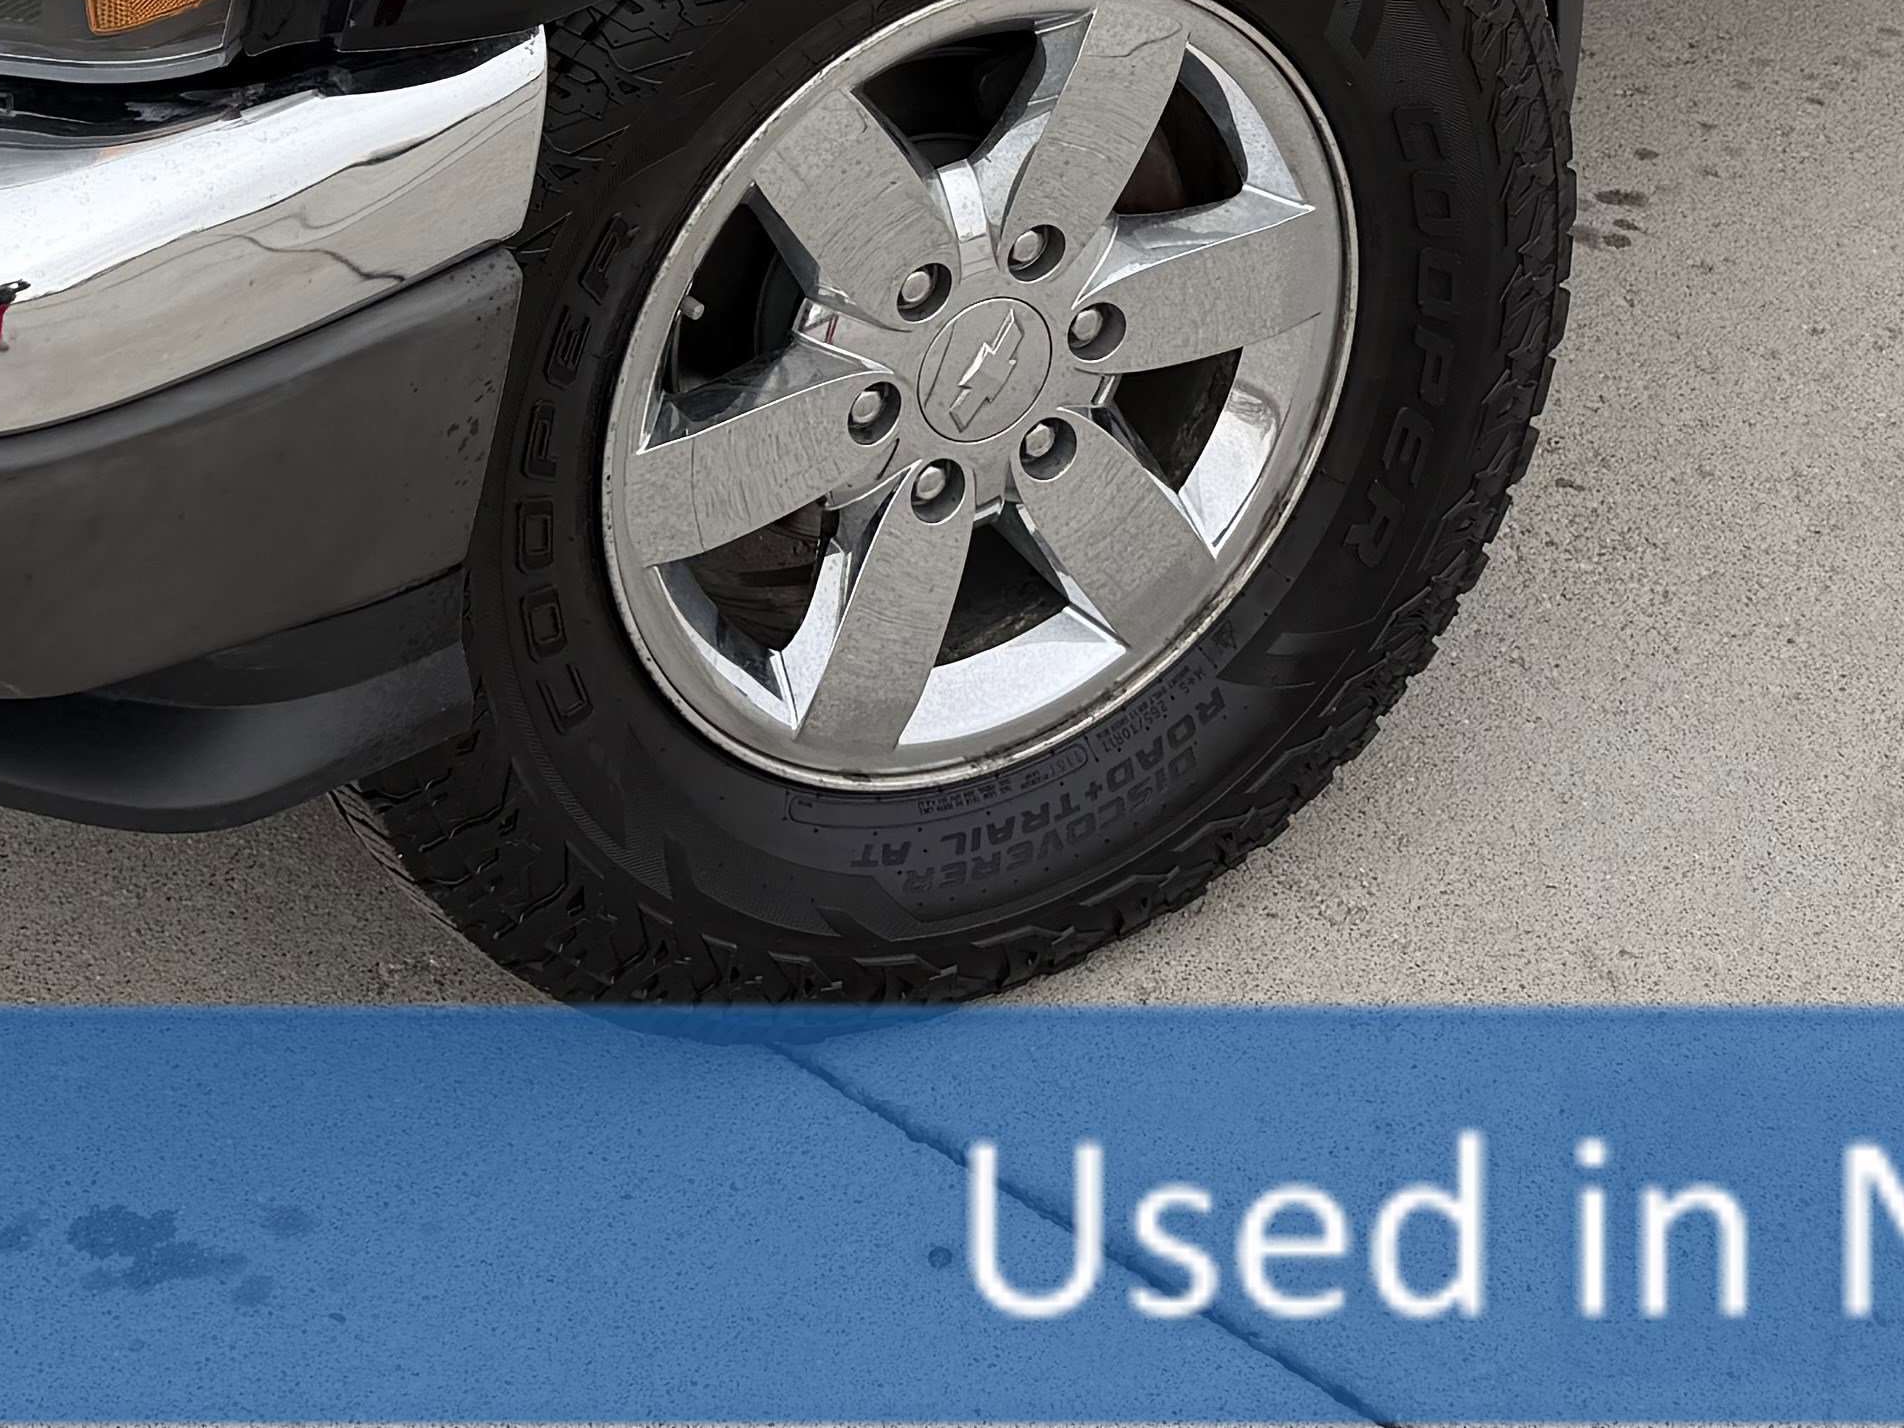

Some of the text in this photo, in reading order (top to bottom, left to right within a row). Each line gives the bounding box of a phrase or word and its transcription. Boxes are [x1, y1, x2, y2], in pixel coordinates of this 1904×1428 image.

[1338, 104, 1456, 568] COOPER
[516, 210, 642, 736] COOPER
[851, 840, 911, 869] AT
[902, 741, 1198, 896] DISCOVERER
[941, 685, 1227, 857] ROAD+TRAIL
